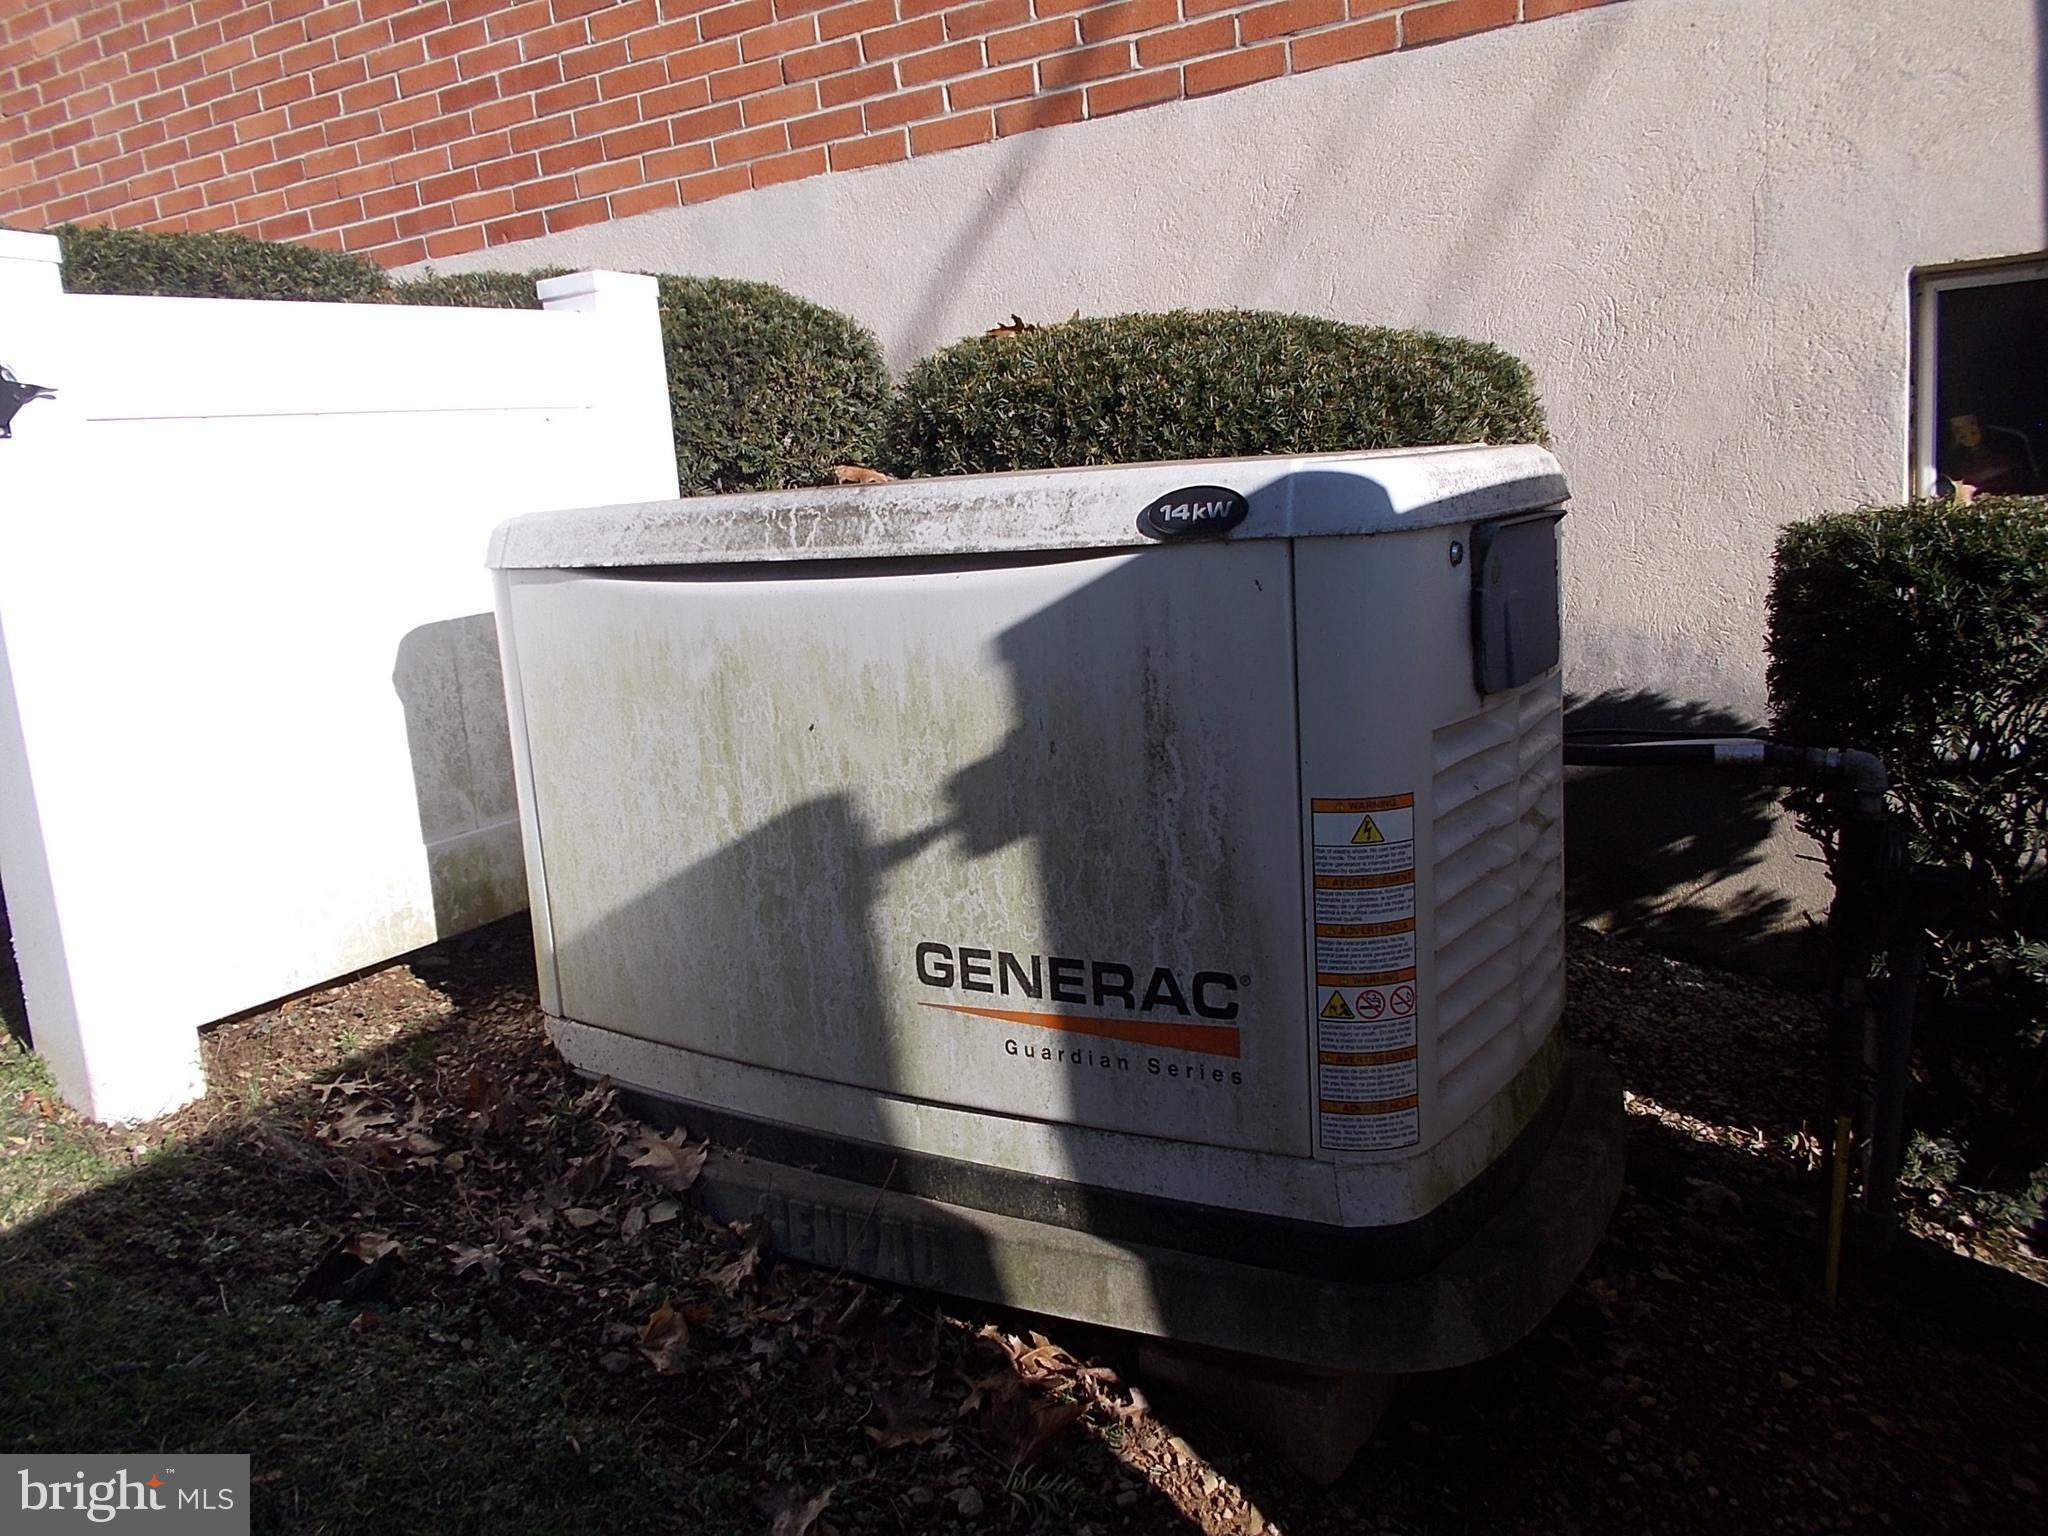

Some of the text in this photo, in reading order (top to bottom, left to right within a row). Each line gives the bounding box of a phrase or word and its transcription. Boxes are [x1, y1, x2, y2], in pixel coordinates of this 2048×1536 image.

[1160, 501, 1233, 521] 14kW
[1348, 799, 1397, 811] WARNING
[916, 942, 1239, 1019] GENERAC
[1352, 973, 1400, 985] WARNING
[1005, 1039, 1242, 1084] Guardian Series
